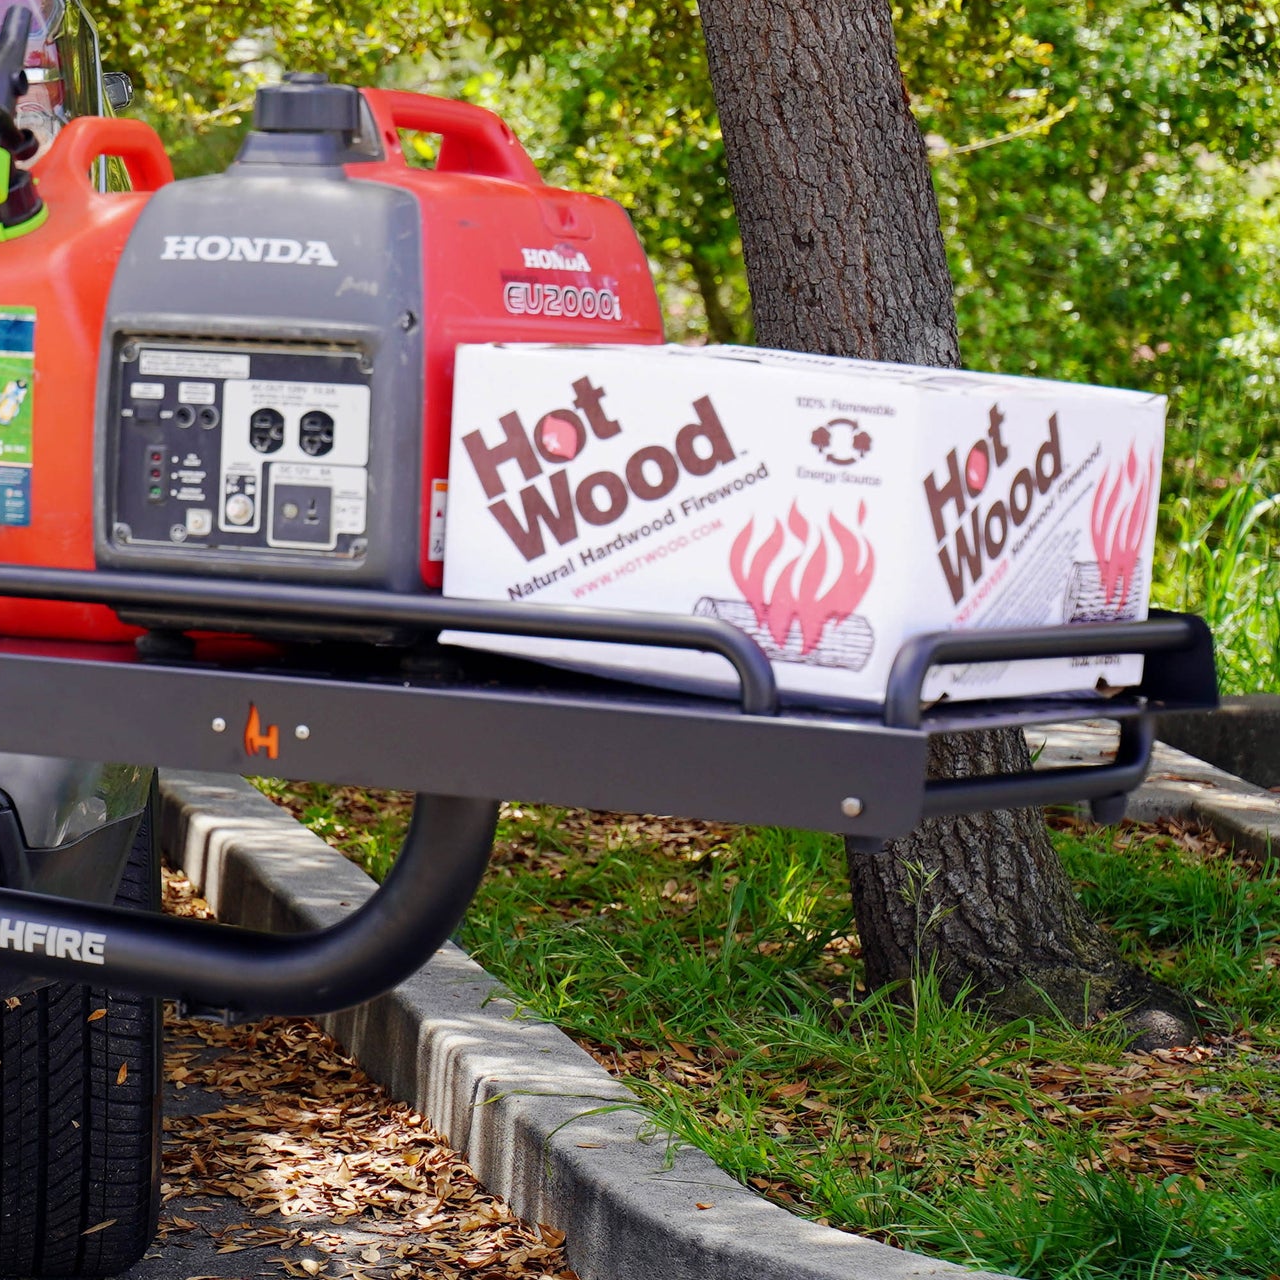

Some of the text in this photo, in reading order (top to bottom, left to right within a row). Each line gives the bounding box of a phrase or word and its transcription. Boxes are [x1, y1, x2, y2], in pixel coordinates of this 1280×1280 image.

[160, 235, 338, 267] HONDA
[503, 280, 623, 321] EU2000i
[461, 375, 622, 500] Hot
[487, 394, 737, 563] Wood
[796, 465, 883, 487] Energy Source
[923, 402, 1009, 543] Hot
[506, 462, 770, 602] Natural Hardwood Firewood
[937, 411, 1063, 606] Wood
